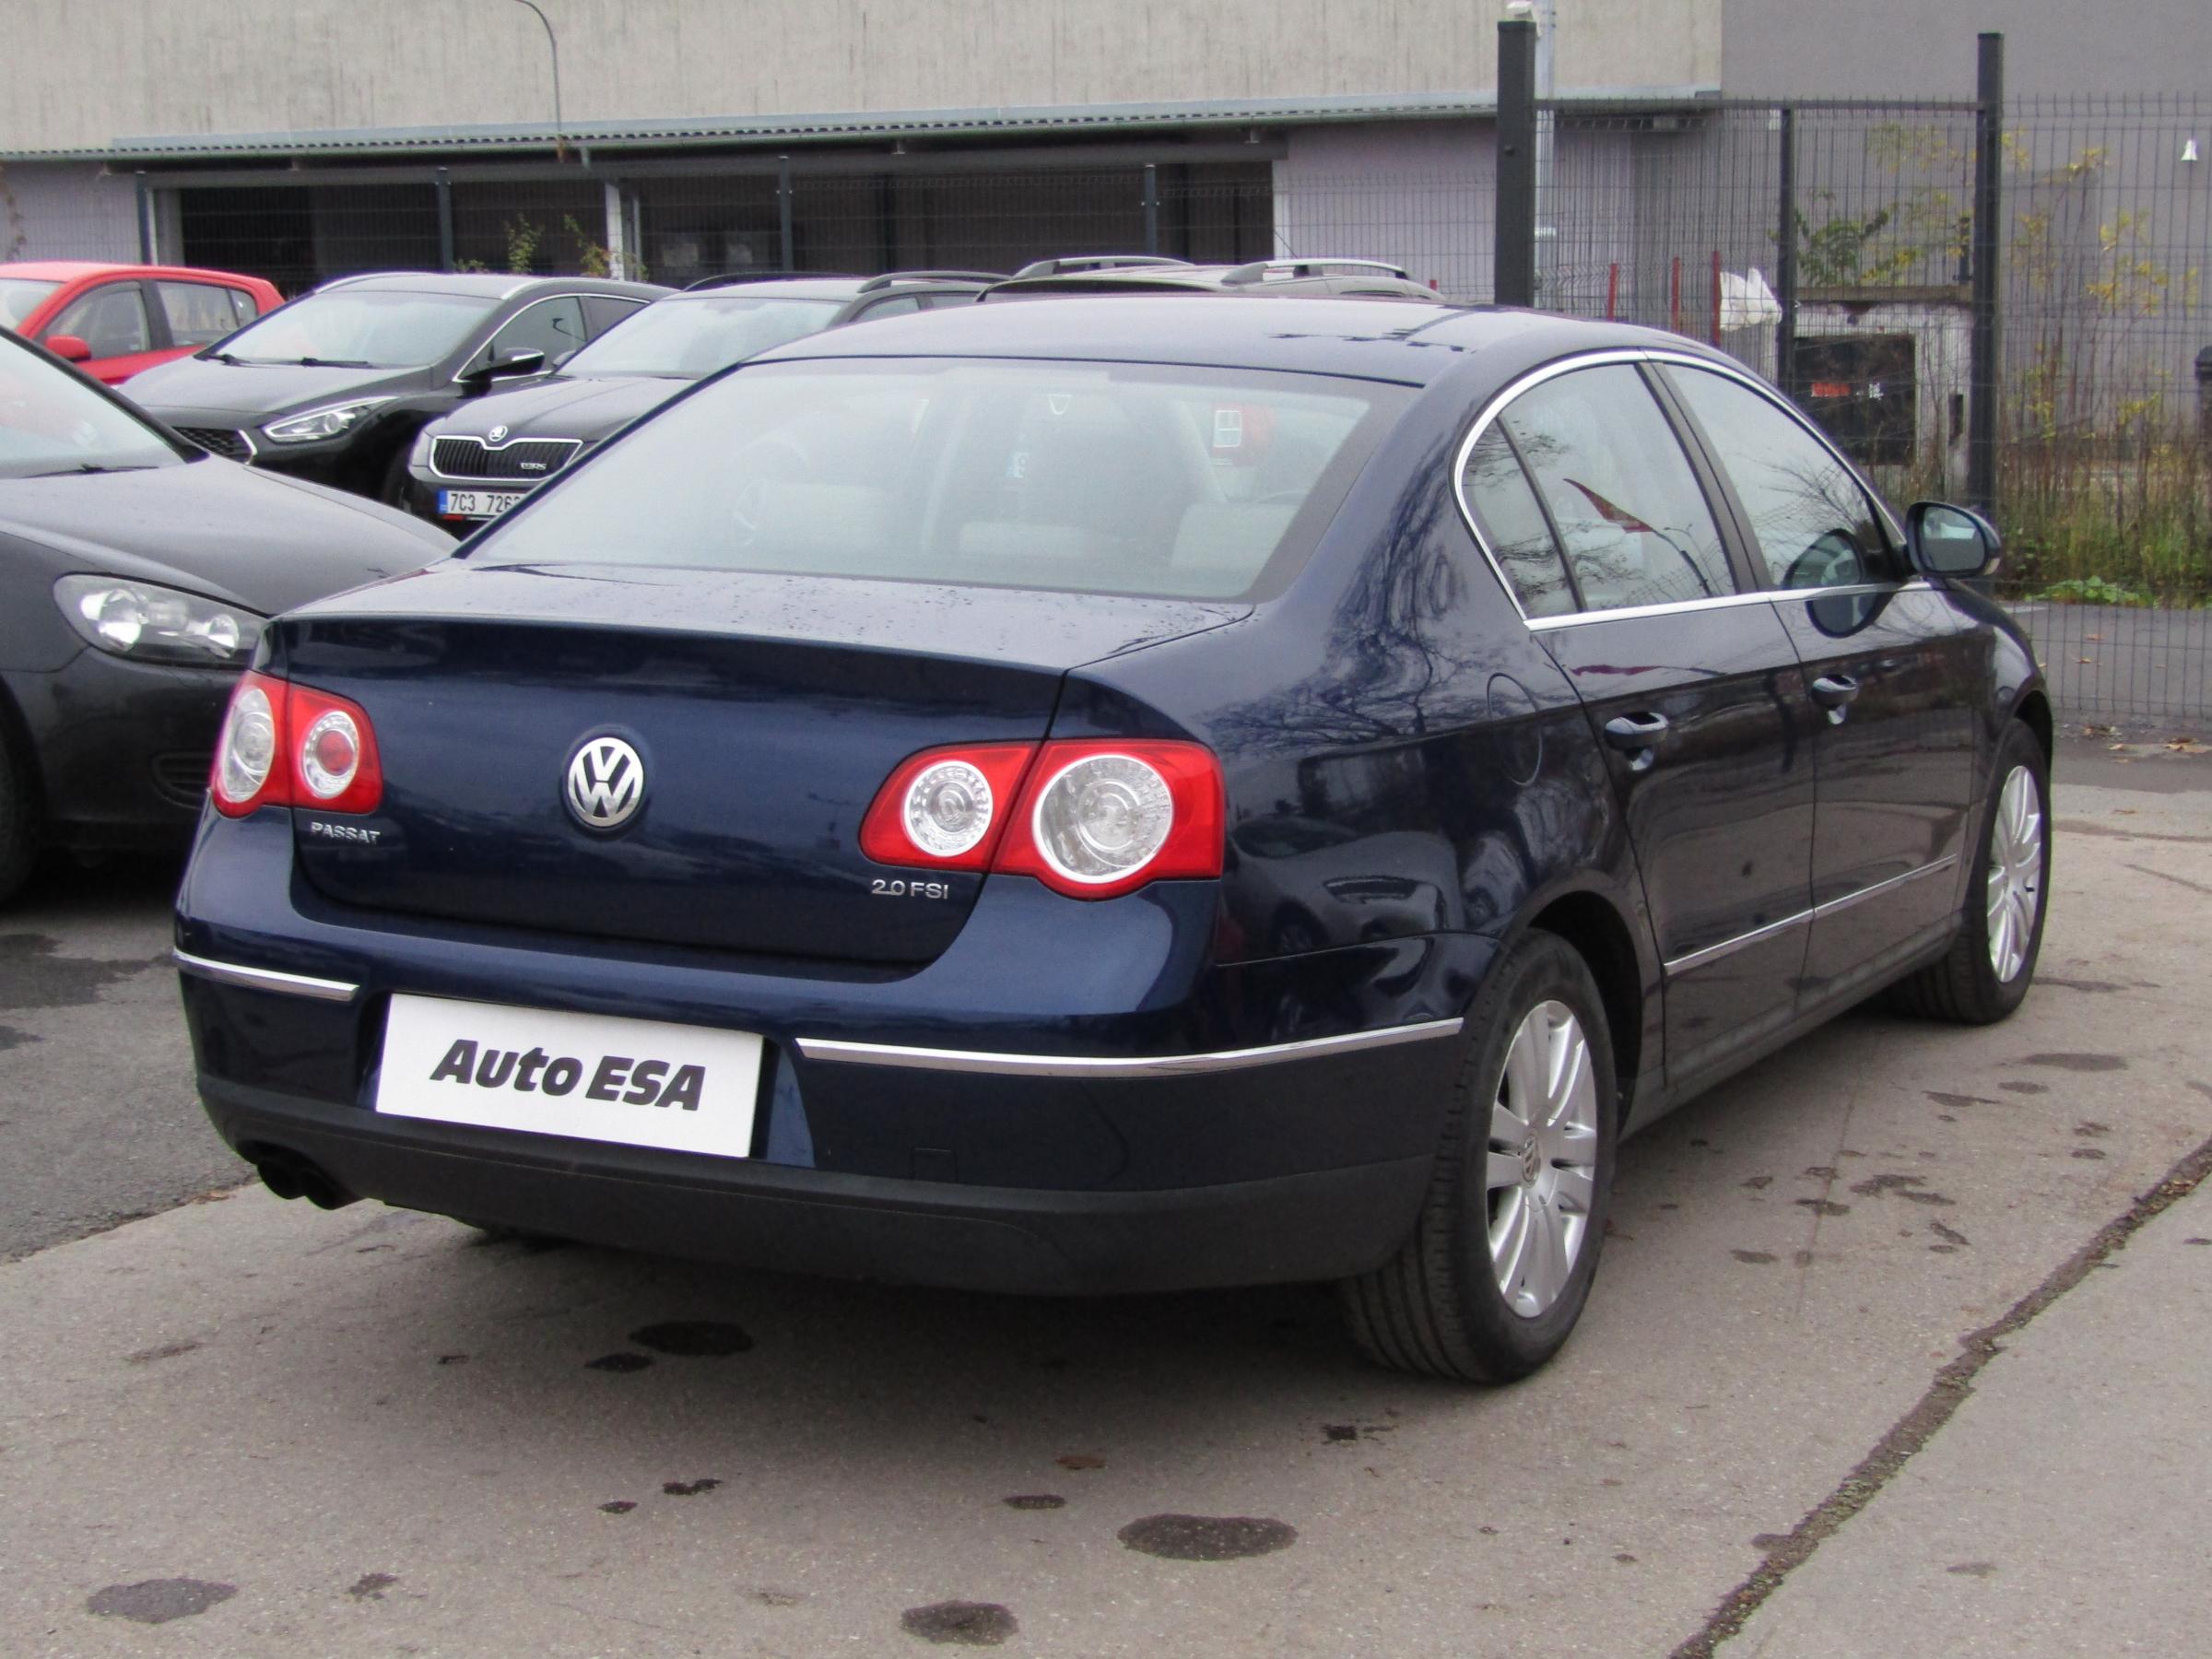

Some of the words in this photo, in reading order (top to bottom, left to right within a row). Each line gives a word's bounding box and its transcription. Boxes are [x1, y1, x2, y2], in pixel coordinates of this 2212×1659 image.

[451, 493, 477, 512] 7C3
[568, 736, 643, 827] VW
[311, 821, 382, 845] PASSAT
[910, 881, 949, 900] FSI
[429, 1039, 583, 1097] Auto
[584, 1055, 707, 1112] ESA
